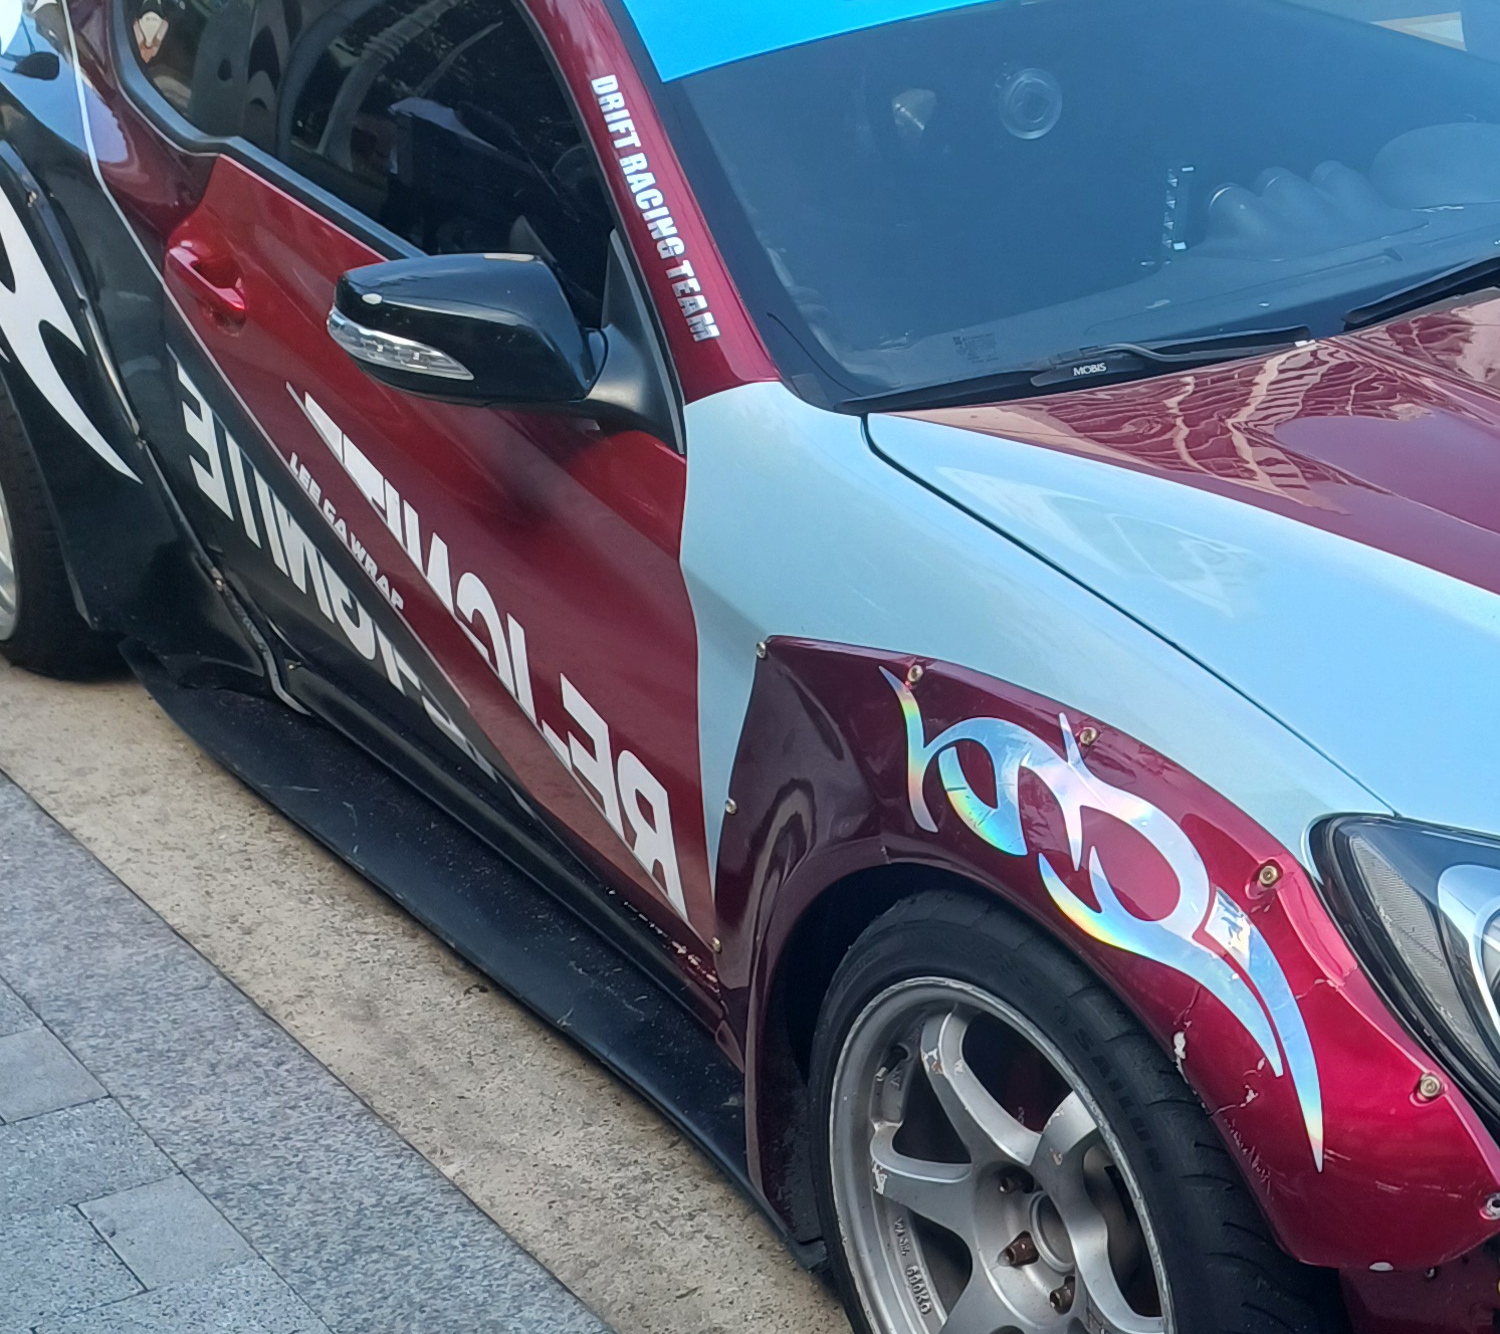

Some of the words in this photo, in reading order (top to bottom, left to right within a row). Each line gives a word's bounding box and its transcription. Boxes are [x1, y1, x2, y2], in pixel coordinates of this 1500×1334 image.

[590, 73, 641, 152] DRIFT
[618, 152, 686, 259] RACING
[666, 259, 720, 343] TEAM
[1073, 362, 1107, 376] MOBIS
[290, 451, 322, 506] LEE
[323, 498, 348, 544] GA
[350, 531, 404, 610] WRAP
